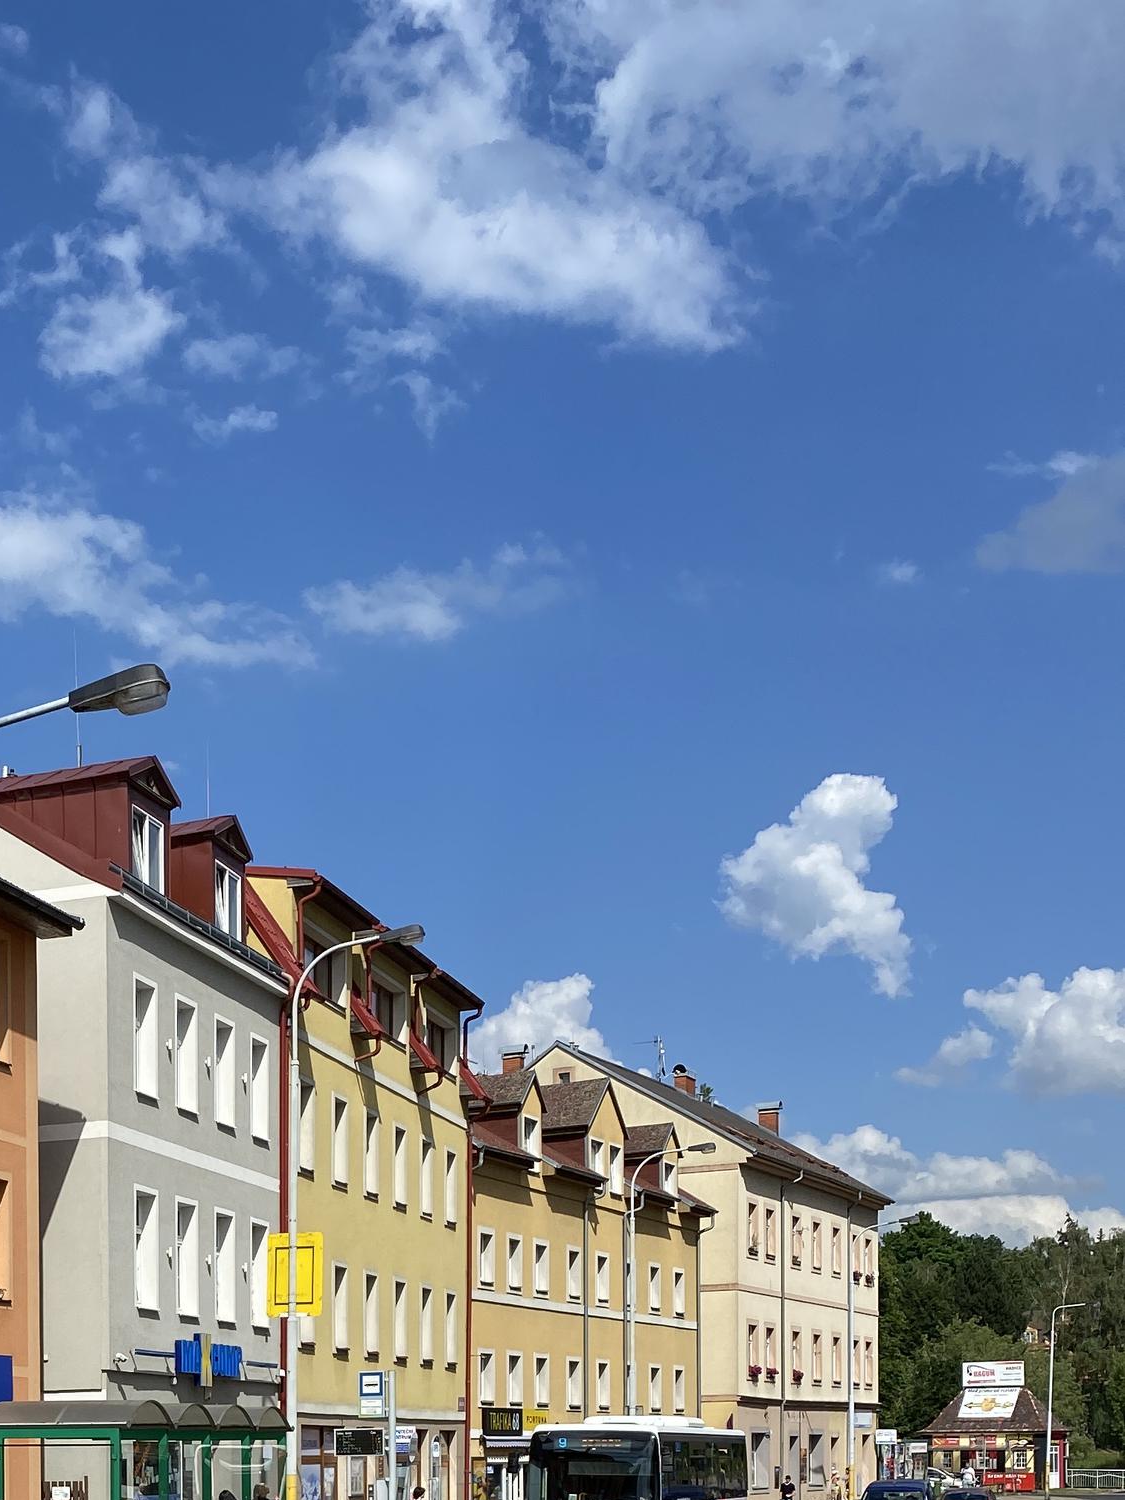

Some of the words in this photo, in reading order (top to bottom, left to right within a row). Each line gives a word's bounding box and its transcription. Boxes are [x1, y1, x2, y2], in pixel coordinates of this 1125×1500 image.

[489, 1412, 511, 1431] TRAFIKA
[512, 1412, 520, 1431] 68
[558, 1437, 567, 1448] 9
